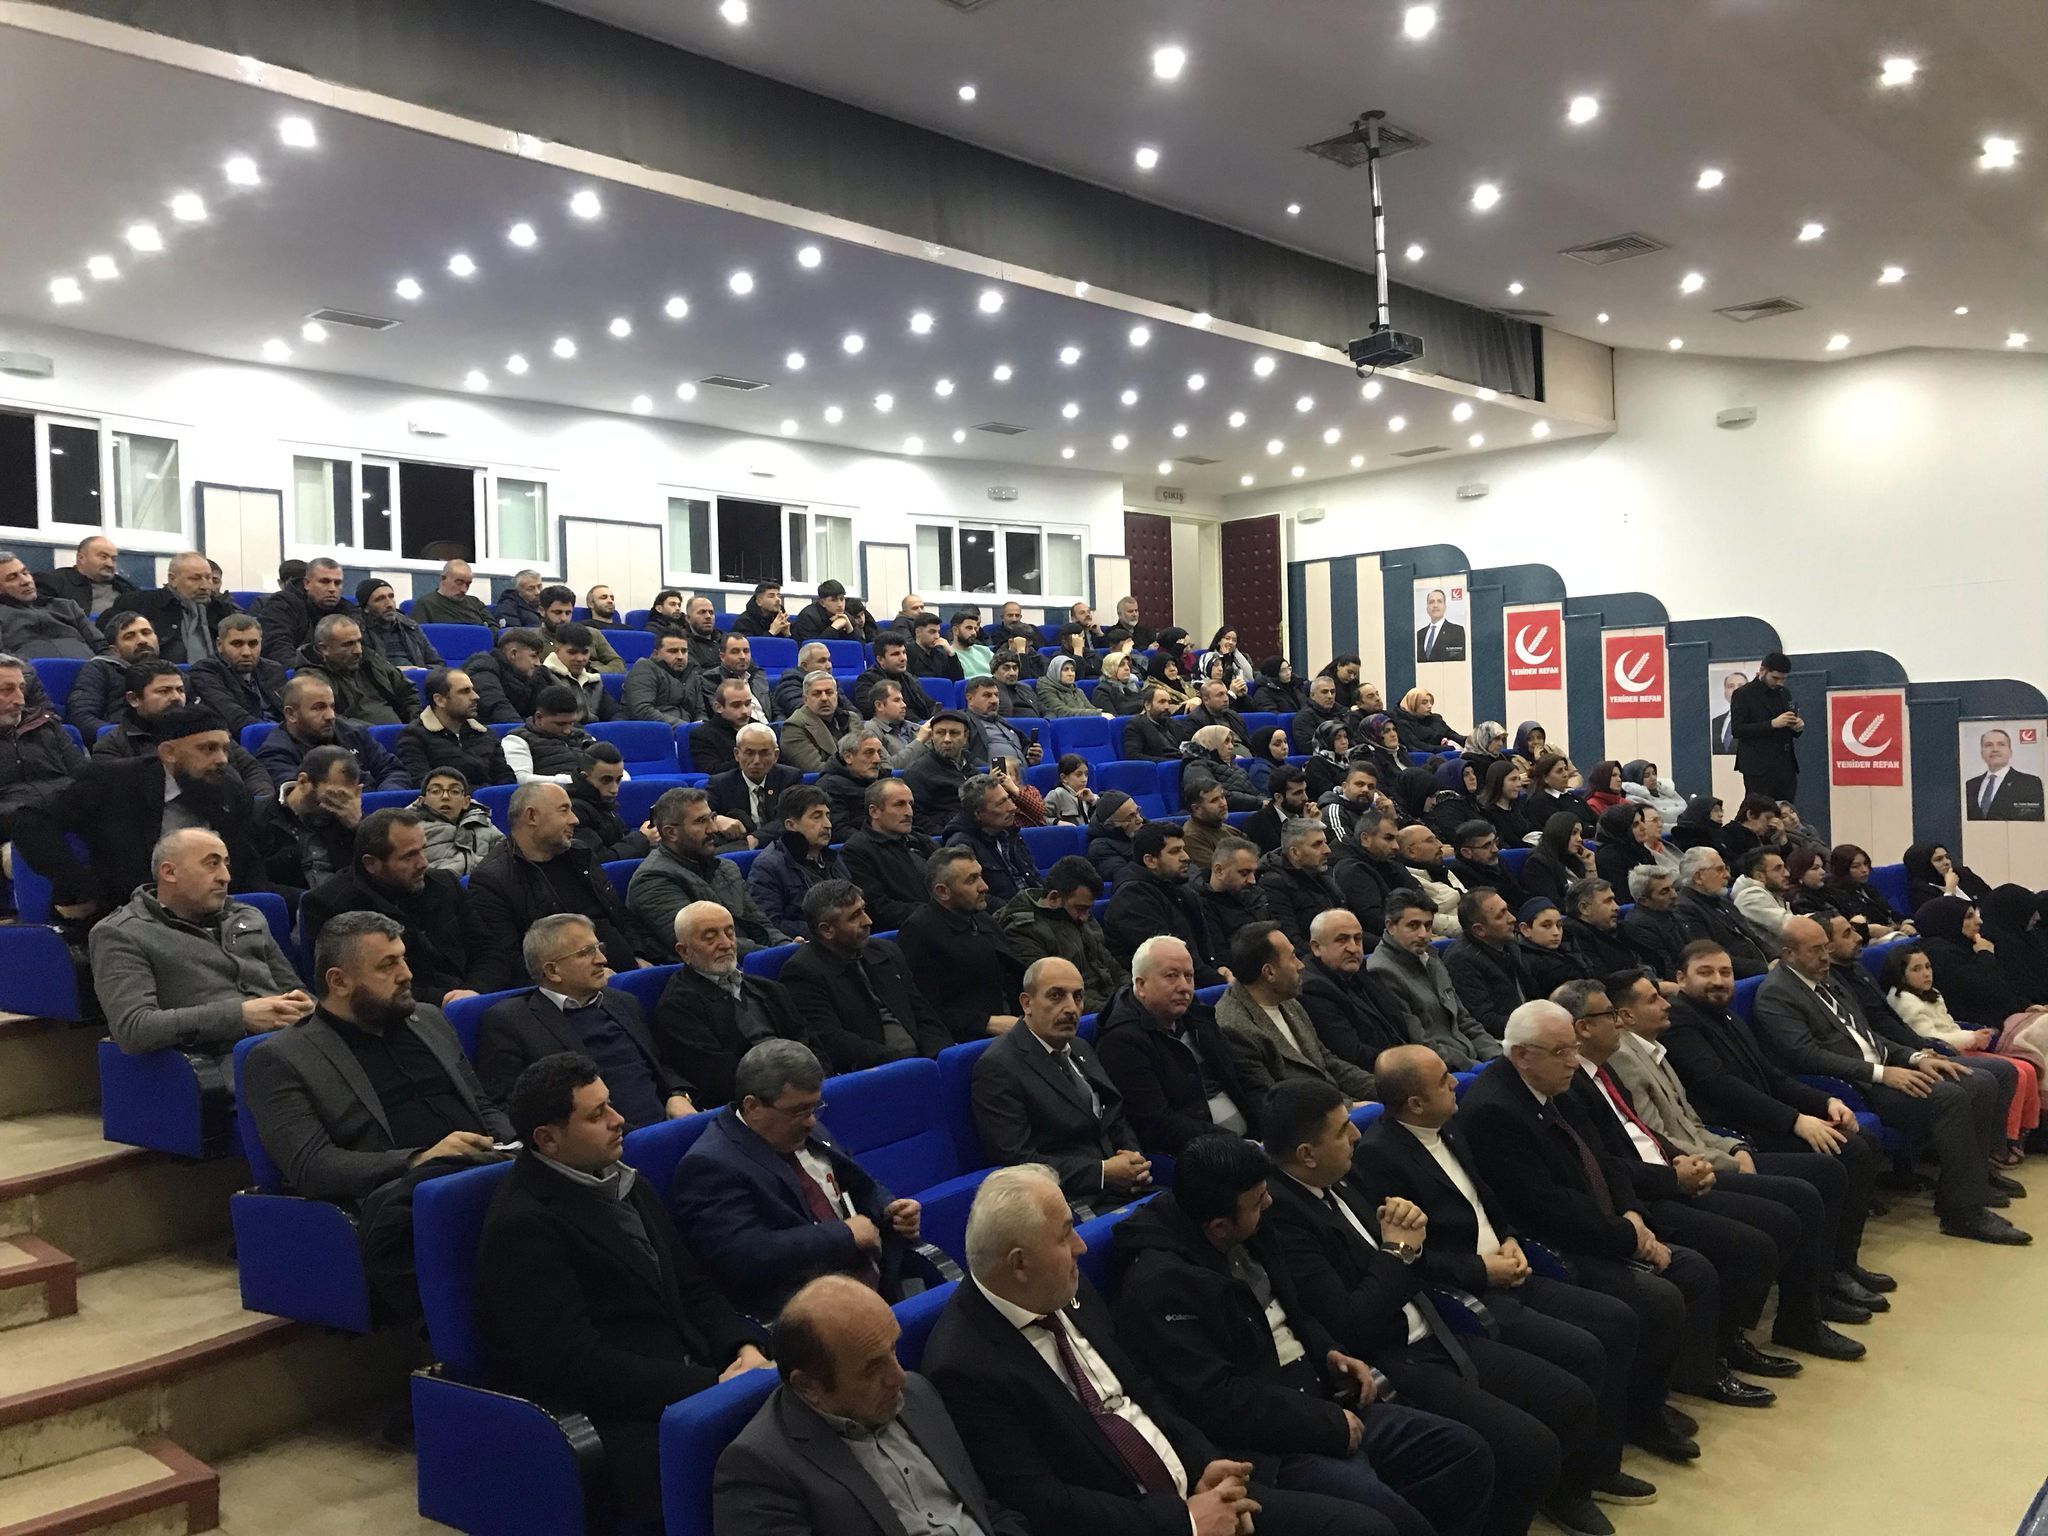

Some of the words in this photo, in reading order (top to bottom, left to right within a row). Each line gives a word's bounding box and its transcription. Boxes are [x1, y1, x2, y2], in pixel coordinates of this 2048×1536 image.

[1510, 667, 1537, 676] YENİDEN
[1538, 666, 1559, 675] REFAH
[1609, 694, 1638, 703] YENİDEN
[1639, 694, 1662, 703] REFAH
[1836, 759, 1871, 769] YENİDEN
[1872, 760, 1900, 769] REFAH
